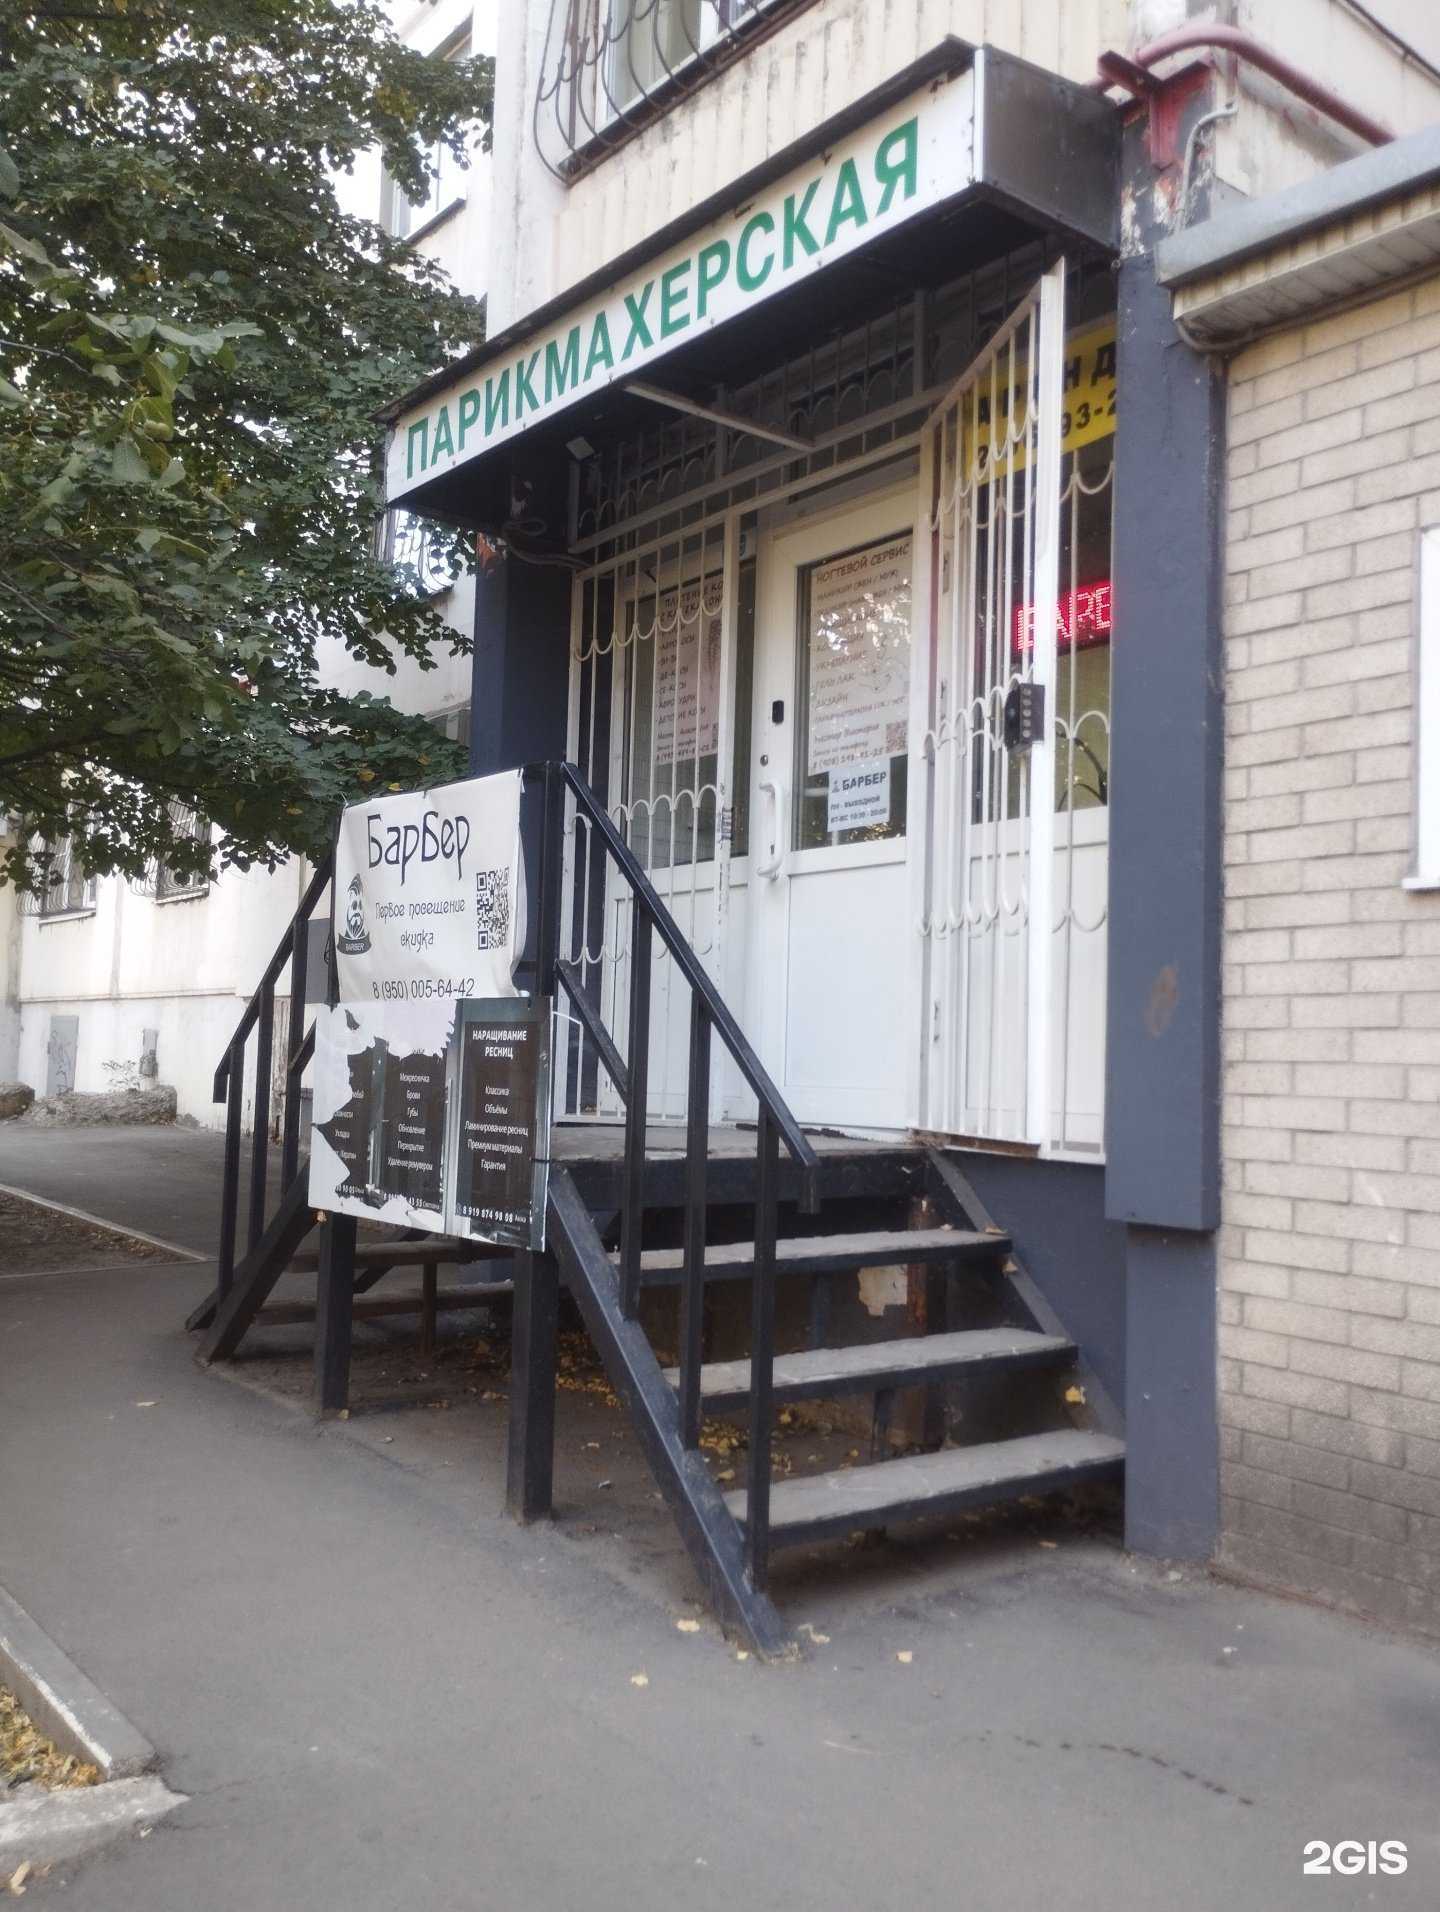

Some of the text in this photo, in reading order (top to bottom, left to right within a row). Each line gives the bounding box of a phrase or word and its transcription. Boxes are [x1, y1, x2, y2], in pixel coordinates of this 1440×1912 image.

[406, 116, 919, 480] ПАРИКМАХЕРСКАЯ
[870, 543, 909, 566] СЕРВИС
[842, 771, 887, 791] БАРБЕР
[372, 977, 475, 1000] 8 (950) 005-64-42
[472, 1030, 527, 1042] НАРАЩИВАНИЕ
[485, 1046, 513, 1060] РЕСНИЦ
